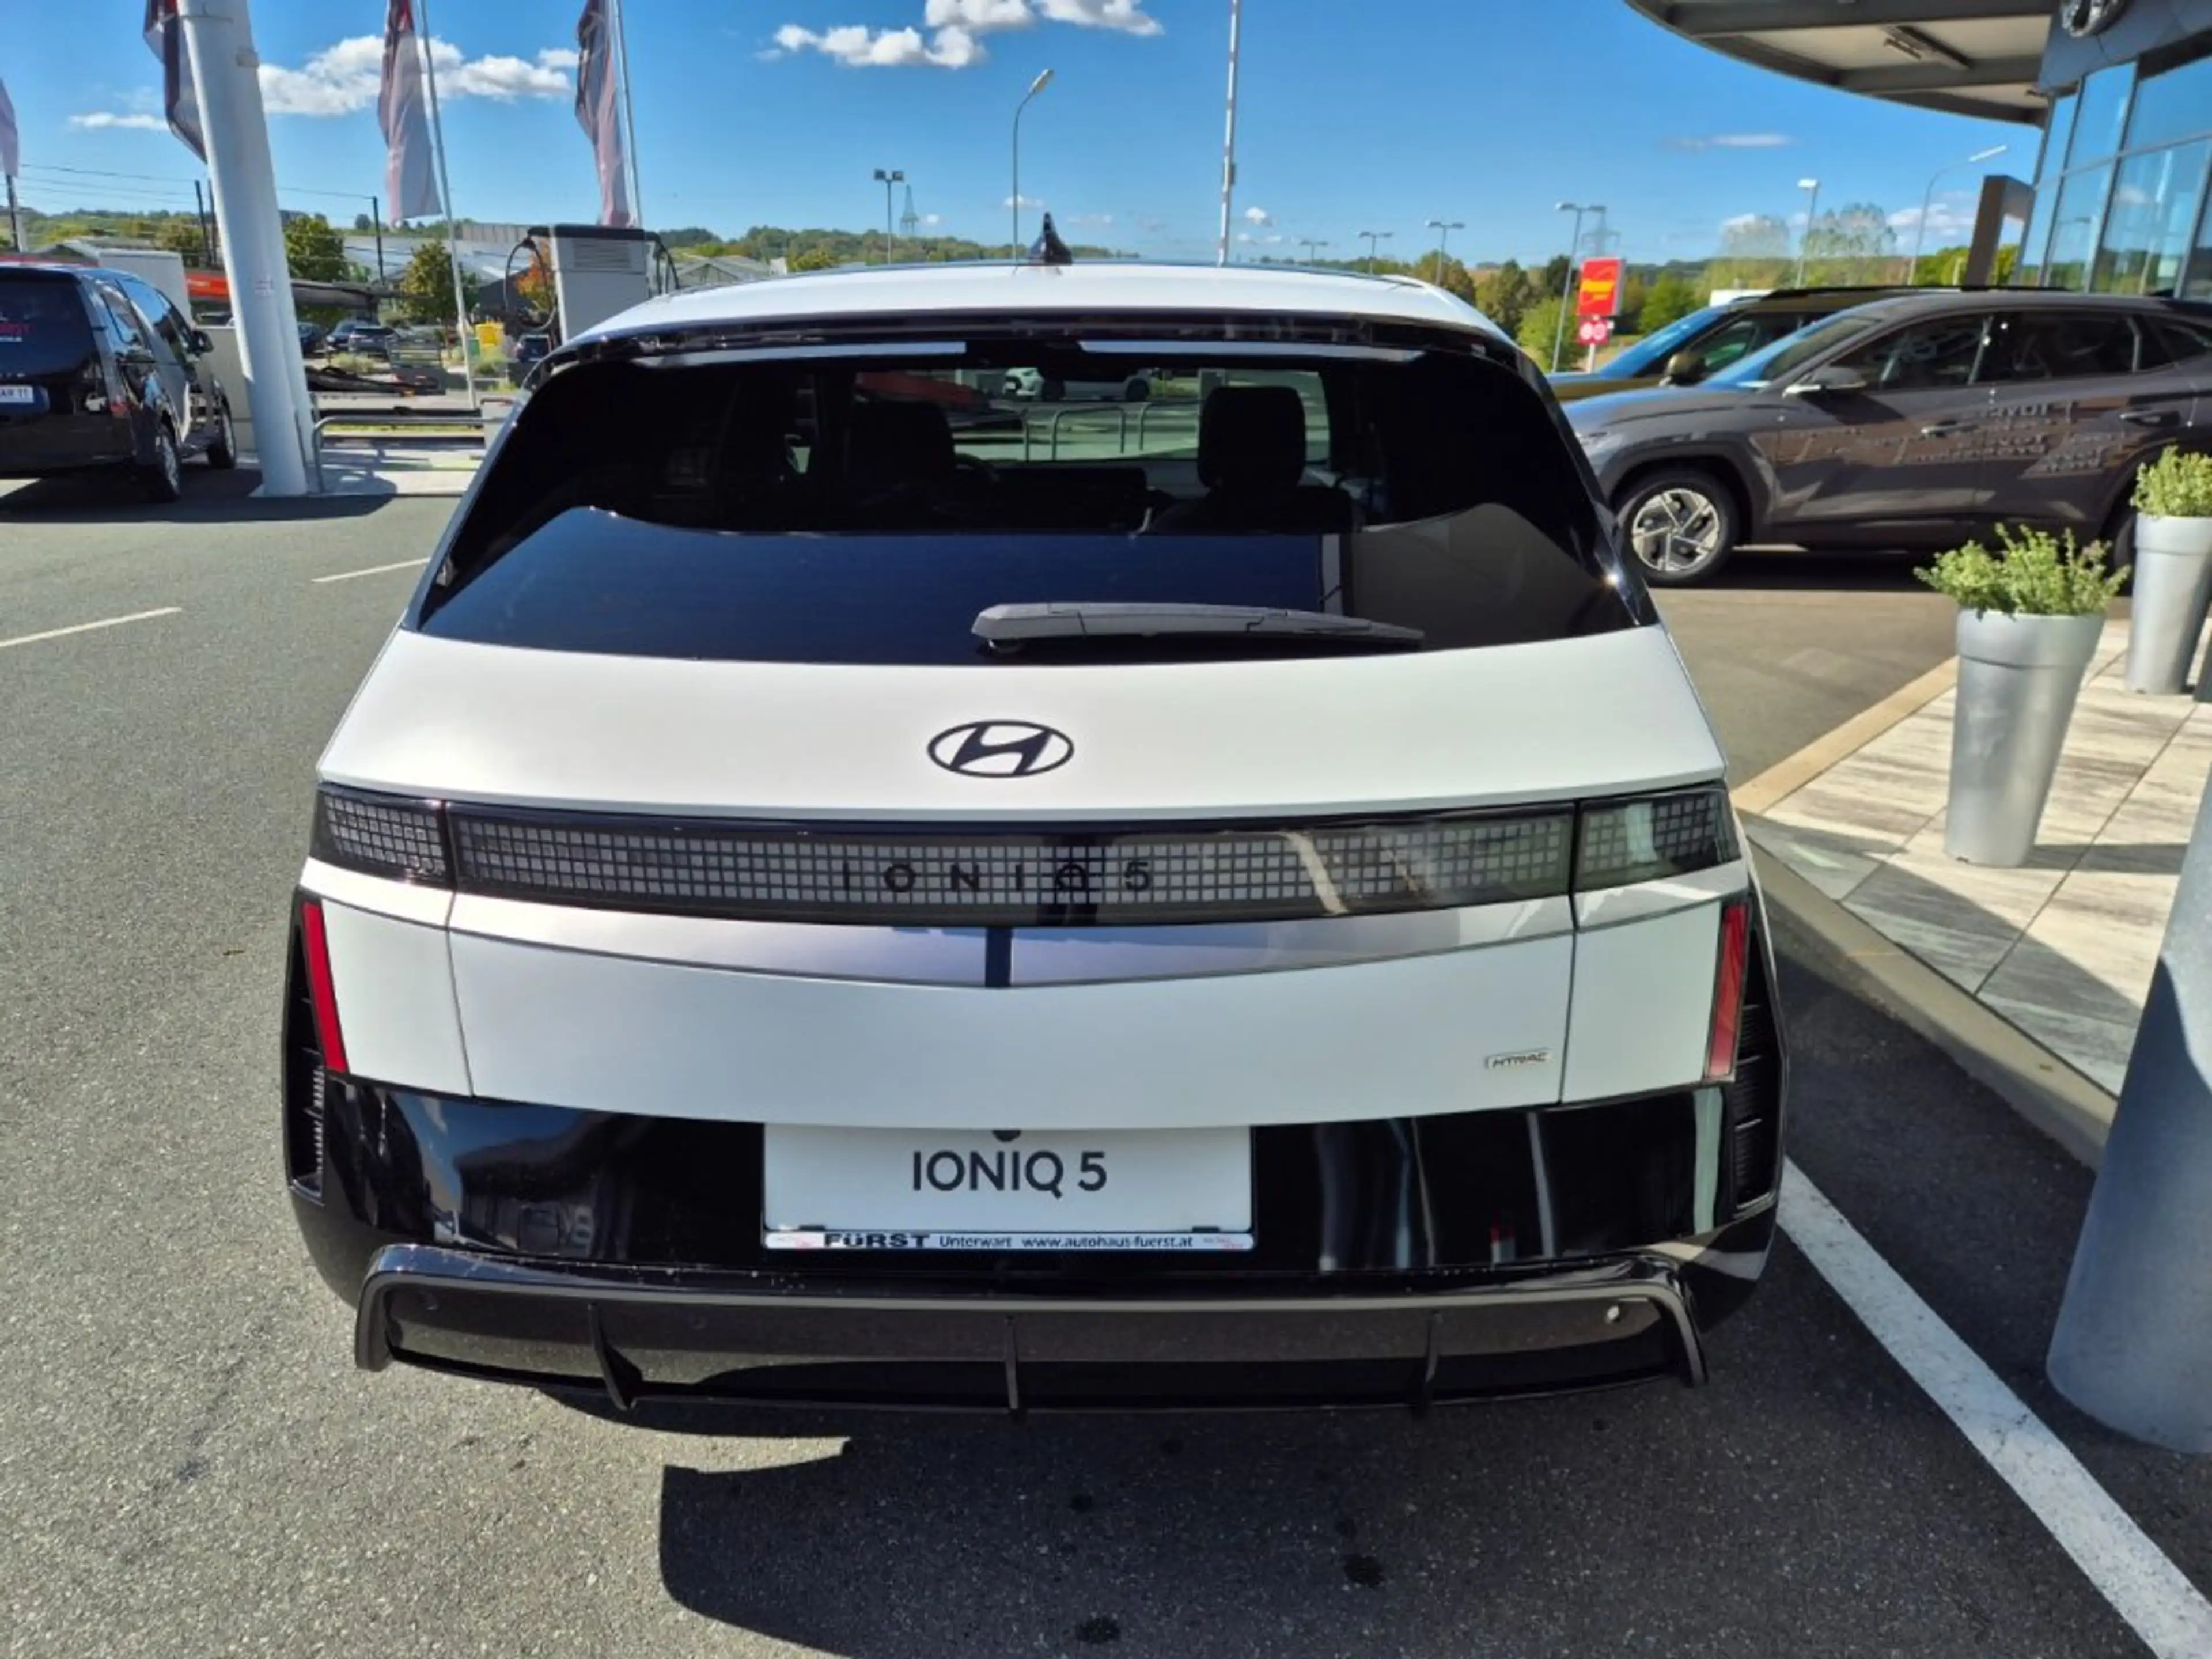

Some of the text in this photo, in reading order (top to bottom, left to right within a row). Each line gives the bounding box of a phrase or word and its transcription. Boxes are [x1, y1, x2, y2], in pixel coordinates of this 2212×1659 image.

[1124, 861, 1150, 891] 5
[913, 1150, 1107, 1199] IONIQ 5
[824, 1233, 930, 1248] FÜRST
[939, 1234, 1012, 1248] Unterwart
[1021, 1236, 1193, 1248] www.autohaus-fuerst.at
